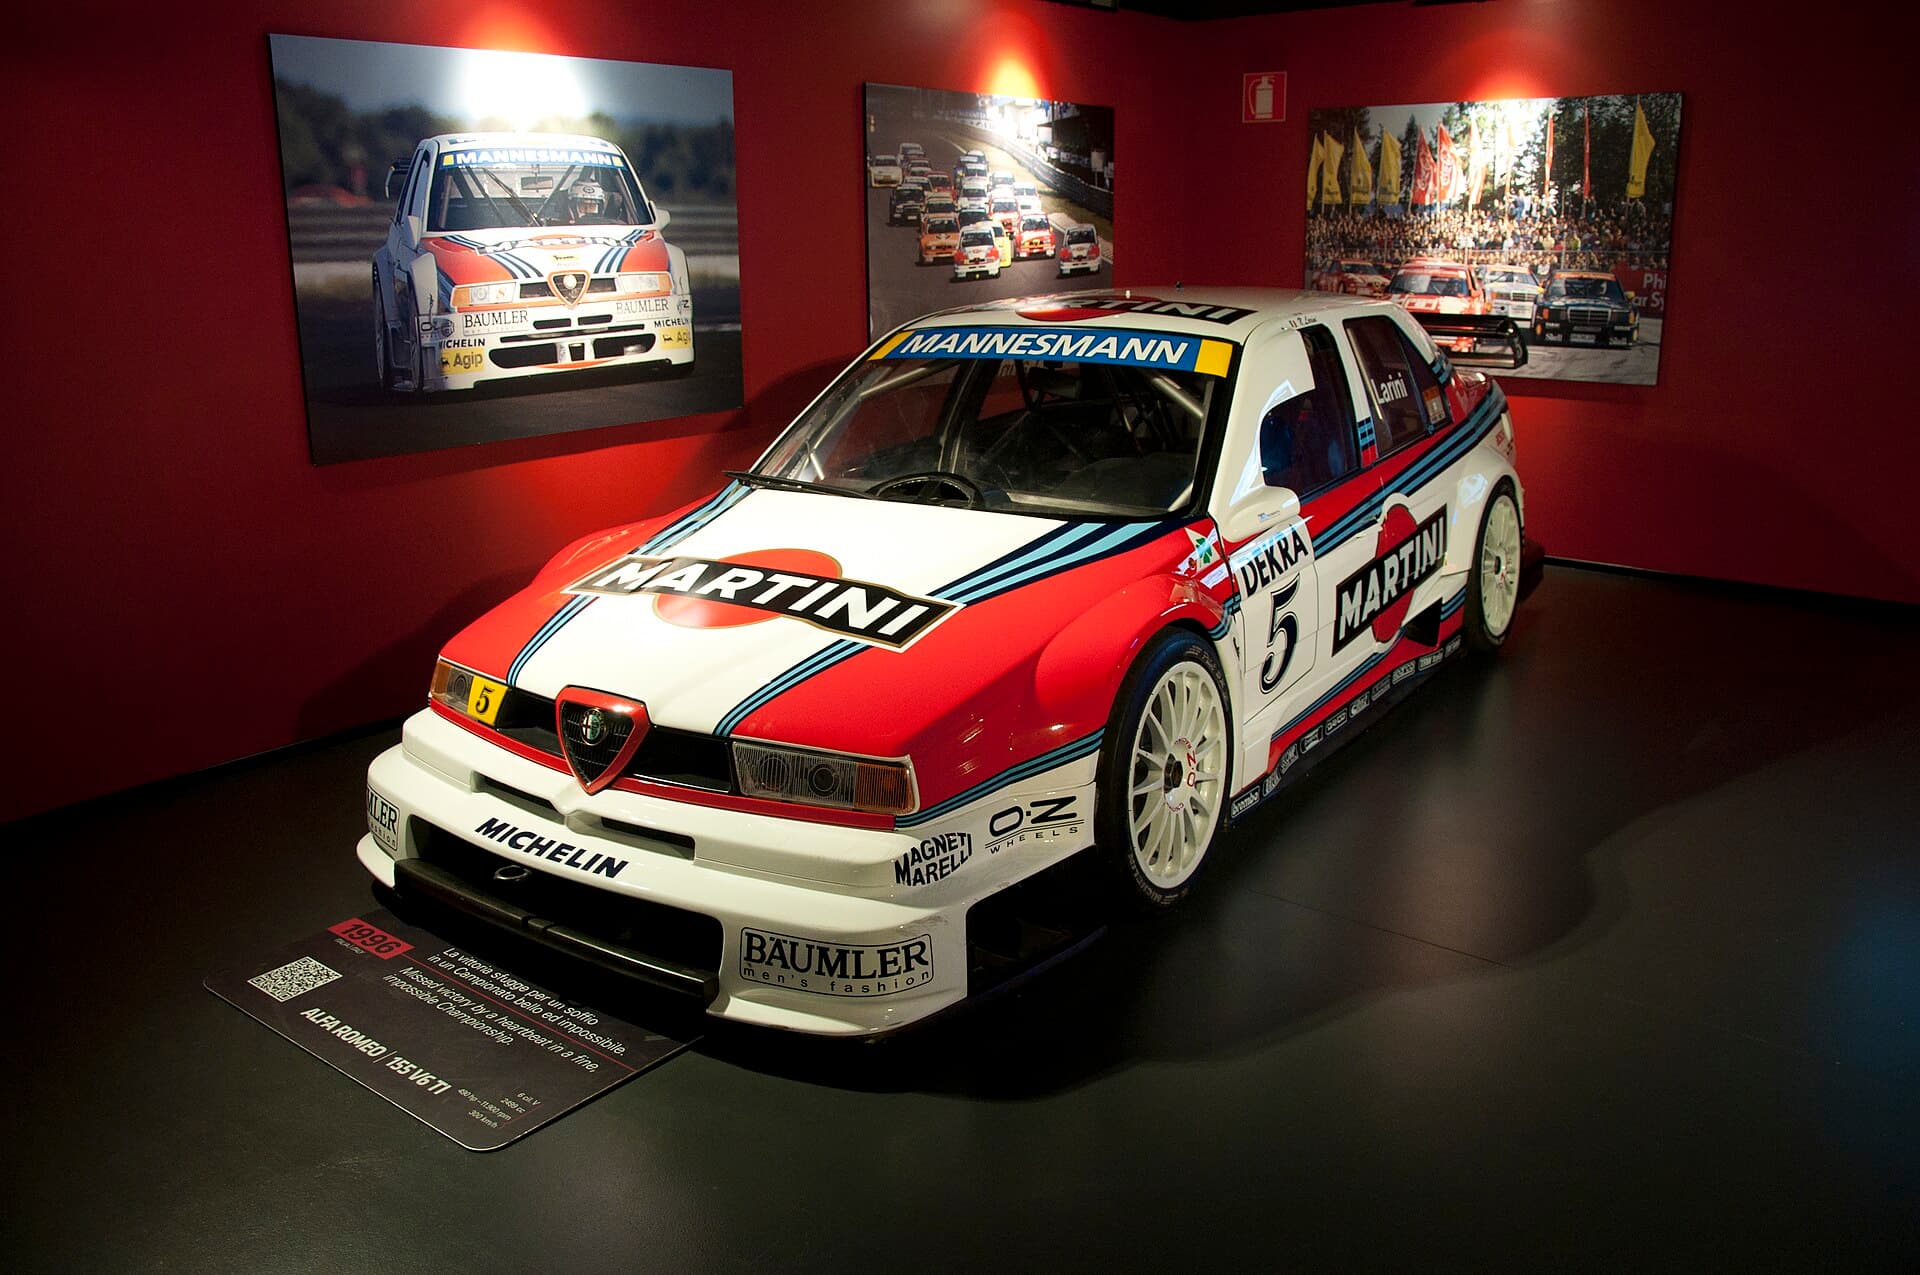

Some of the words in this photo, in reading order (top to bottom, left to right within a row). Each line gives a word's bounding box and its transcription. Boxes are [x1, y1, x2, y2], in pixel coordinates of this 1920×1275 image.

[456, 147, 613, 166] MANNESMANN
[453, 352, 484, 370] Agip
[900, 331, 1190, 365] MANNESMANN
[1370, 371, 1409, 405] Larini
[1240, 527, 1309, 598] DEKRA
[1338, 514, 1446, 641] MARTINI
[592, 561, 931, 637] MARTINI
[1260, 571, 1301, 695] 5
[475, 685, 496, 716] 5
[475, 817, 630, 880] MICHELIN
[894, 832, 973, 877] MAGNETI
[989, 826, 1080, 855] WHEELS
[894, 846, 973, 887] MARELLI
[341, 923, 402, 954] 1996
[744, 930, 930, 981] BÄUMLER
[443, 947, 460, 958] La
[458, 955, 493, 975] vittoria
[490, 972, 530, 992] sfugge
[524, 989, 551, 1002] per
[547, 999, 565, 1010] un
[563, 1007, 599, 1026] soffio
[742, 963, 809, 989] men's
[829, 970, 931, 994] fashion
[382, 973, 440, 1005] impossible
[435, 1001, 514, 1046] Championship.
[399, 966, 444, 990] Missed
[435, 983, 475, 1008] victory
[470, 1003, 492, 1019] by
[485, 1011, 499, 1019] a
[494, 1015, 553, 1047] heartbeat
[547, 1042, 565, 1054] in
[560, 1050, 575, 1058] a
[570, 1054, 600, 1073] fine,
[427, 953, 441, 963] in
[438, 960, 456, 971] un
[453, 967, 517, 1001] Campionato
[513, 996, 544, 1014] bello
[541, 1011, 564, 1023] ed
[557, 1017, 626, 1056] impossibile.
[300, 1007, 341, 1031] ALFA
[331, 1024, 388, 1058] ROMEO
[385, 1056, 419, 1075] 155
[407, 1068, 437, 1087] V6
[427, 1079, 453, 1096] TI
[495, 1110, 513, 1121] rpm
